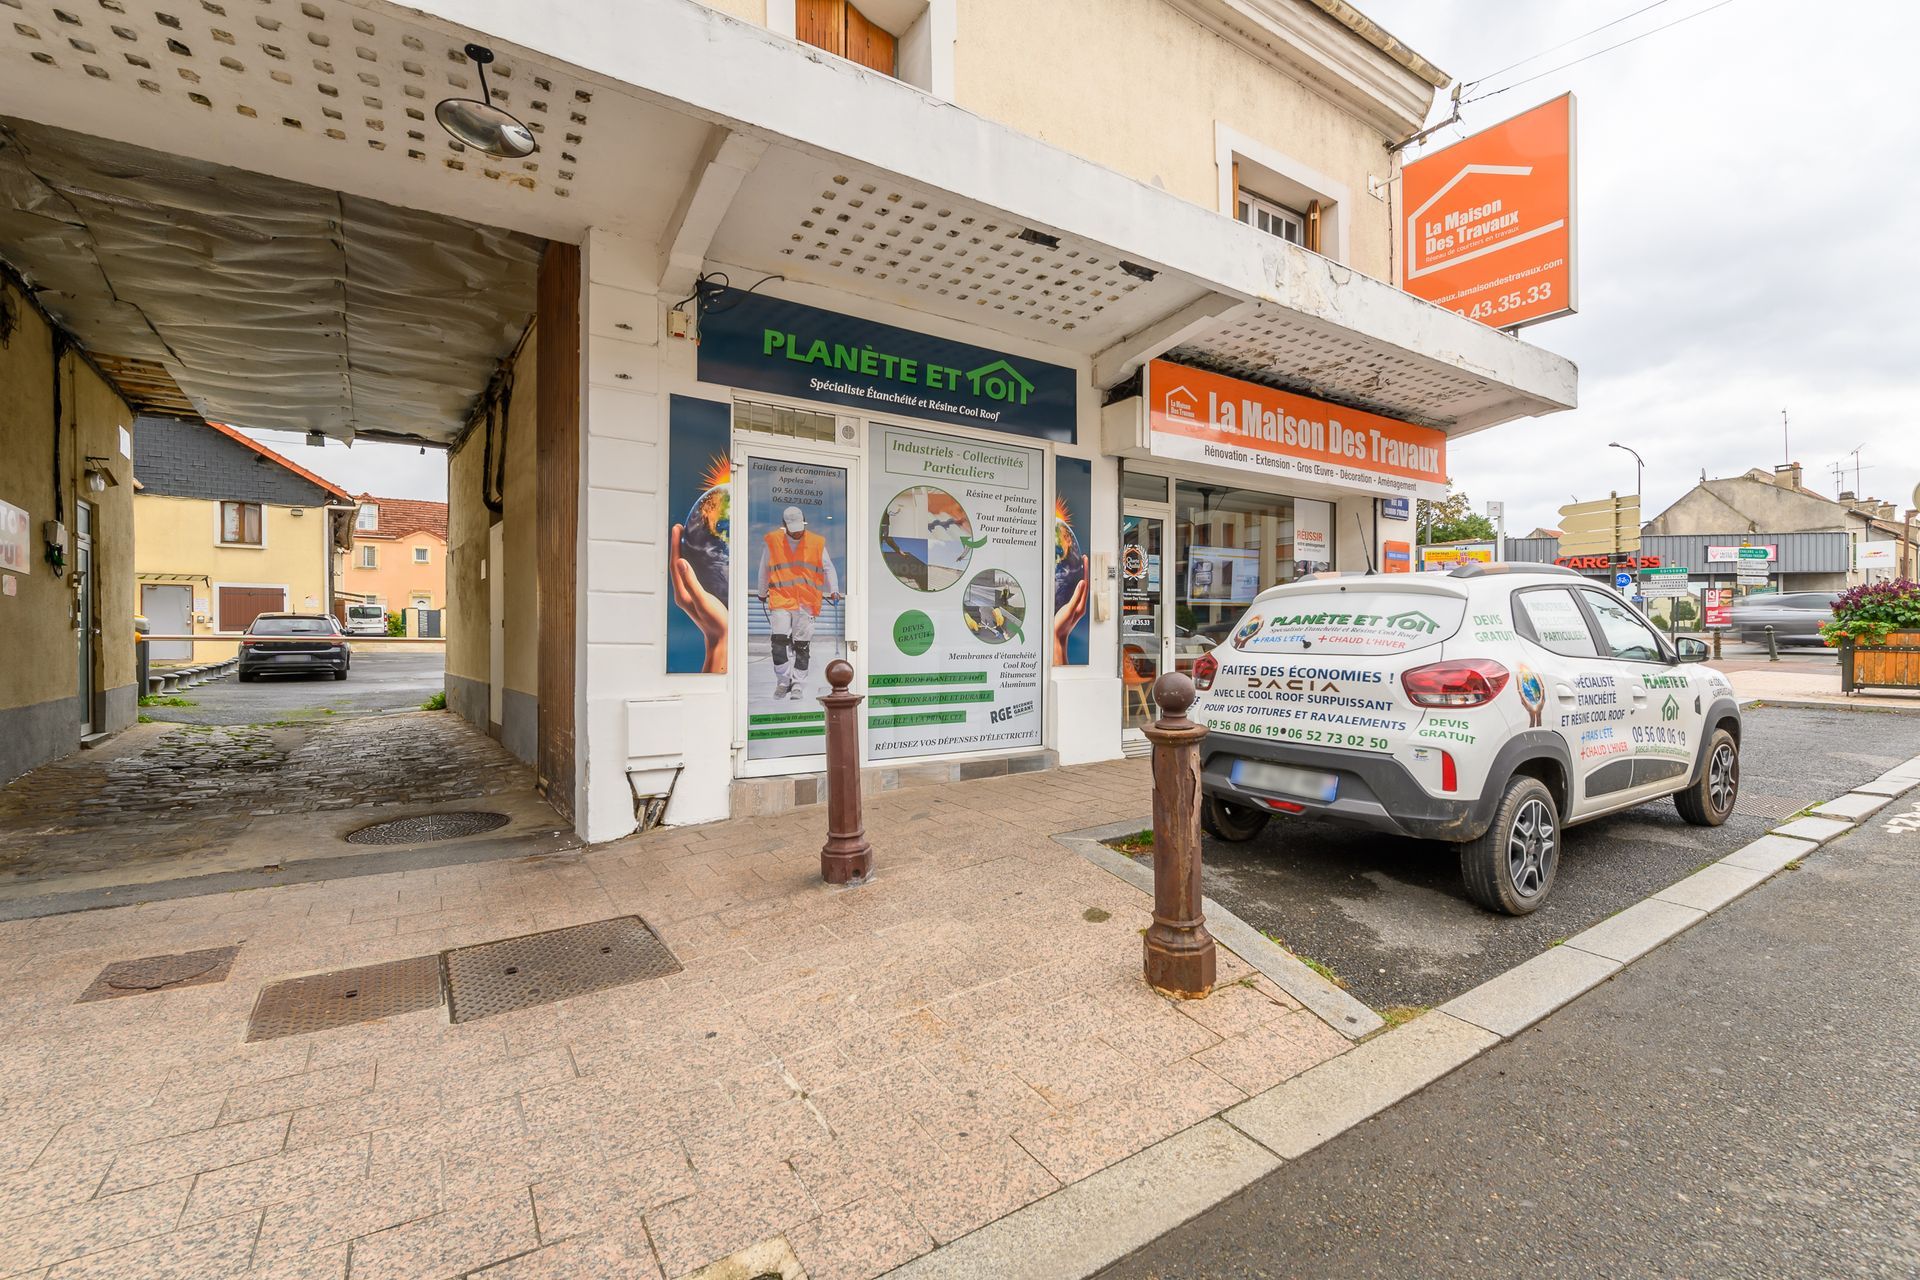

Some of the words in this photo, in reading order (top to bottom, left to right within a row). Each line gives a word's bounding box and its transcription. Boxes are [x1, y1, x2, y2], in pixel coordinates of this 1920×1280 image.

[1425, 222, 1442, 238] La
[1444, 199, 1502, 231] Maison
[1425, 235, 1454, 255] Des
[1456, 210, 1519, 243] Travaux
[763, 328, 918, 383] PLANÈTE
[926, 363, 962, 391] ET
[966, 359, 1035, 405] TOIT
[809, 377, 865, 397] Spécialiste
[866, 386, 917, 406] Étanchéité
[918, 400, 927, 408] et
[928, 399, 958, 413] Résine
[959, 405, 979, 417] Cool
[979, 409, 1000, 422] Roof
[1209, 391, 1236, 434] La
[1242, 399, 1325, 451] Maison
[1329, 419, 1366, 460] Des
[1369, 429, 1439, 474] Travaux
[892, 440, 953, 458] Industriels
[962, 450, 1024, 468] Collectivités
[752, 462, 777, 472] Faites
[779, 464, 793, 473] des
[795, 467, 837, 477] économies
[923, 460, 995, 480] Particuliers
[1204, 444, 1248, 462] Rénovation
[1256, 454, 1290, 470] Extension
[1297, 461, 1312, 473] Gros
[1313, 465, 1334, 477] Œuvre
[1340, 469, 1372, 484] Décoration
[1377, 476, 1417, 492] Aménagement
[966, 489, 993, 500] Résine
[994, 492, 1002, 500] et
[1003, 494, 1037, 504] peinture
[1005, 505, 1037, 515] Isolante
[976, 512, 995, 521] Tout
[996, 514, 1037, 526] matériaux
[980, 524, 1000, 533] Pour
[1001, 526, 1028, 536] toiture
[1029, 528, 1037, 536] et
[992, 537, 1037, 547] ravalement
[1554, 555, 1661, 569] CARGASS
[1270, 612, 1352, 627] PLANÈTE
[1353, 614, 1383, 626] ET
[1386, 610, 1440, 634] TOIT
[1473, 614, 1503, 626] DEVIS
[902, 623, 924, 633] DEVIS
[1366, 637, 1406, 649] L'HIVER
[1474, 630, 1515, 642] GRATUIT
[948, 652, 993, 661] Membranes
[994, 651, 1037, 660] d'étanchéité
[1003, 661, 1019, 669] Cool
[1020, 661, 1038, 670] Roof
[871, 677, 882, 685] LE
[882, 676, 904, 685] COOL
[1000, 671, 1037, 679] Bitumeuse
[1221, 664, 1257, 676] FAITES
[1260, 665, 1285, 678] DES
[1289, 664, 1382, 683] ÉCONOMIES
[1248, 677, 1340, 692] DACIA
[1680, 676, 1689, 688] ET
[1213, 689, 1234, 698] AVEC
[1236, 690, 1246, 698] LE
[1247, 689, 1273, 700] COOL
[1275, 692, 1304, 702] ROOF
[1307, 694, 1393, 711] SURPUISSANT
[990, 706, 1012, 724] RGE
[1204, 703, 1225, 712] POUR
[1226, 704, 1243, 713] VOS
[1246, 706, 1291, 718] TOITURES
[1294, 710, 1308, 719] ET
[1310, 712, 1407, 731] RAVALEMENTS
[1561, 715, 1569, 727] ET
[1590, 709, 1607, 723] COOL
[1608, 709, 1625, 720] ROOF
[1429, 718, 1469, 729] DEVIS
[875, 739, 919, 751] RÉDUISEZ
[919, 738, 936, 747] VOS
[939, 735, 979, 746] DÉPENSES
[979, 730, 1034, 742] D'ÉLECTRICITÉ
[1207, 719, 1218, 729] 09
[1220, 720, 1231, 730] 56
[1233, 721, 1246, 732] 08
[1249, 723, 1262, 735] 06
[1266, 725, 1279, 737] 19
[1287, 728, 1303, 739] 06
[1306, 730, 1321, 742] 52
[1327, 732, 1342, 744] 73
[1347, 735, 1364, 747] 02
[1369, 737, 1388, 750] 50
[1419, 729, 1476, 745] GRATUIT
[1632, 726, 1642, 743] 09
[1644, 726, 1654, 743] 56
[1655, 727, 1665, 743] 08
[1667, 728, 1677, 744] 06
[1677, 730, 1686, 747] 19
